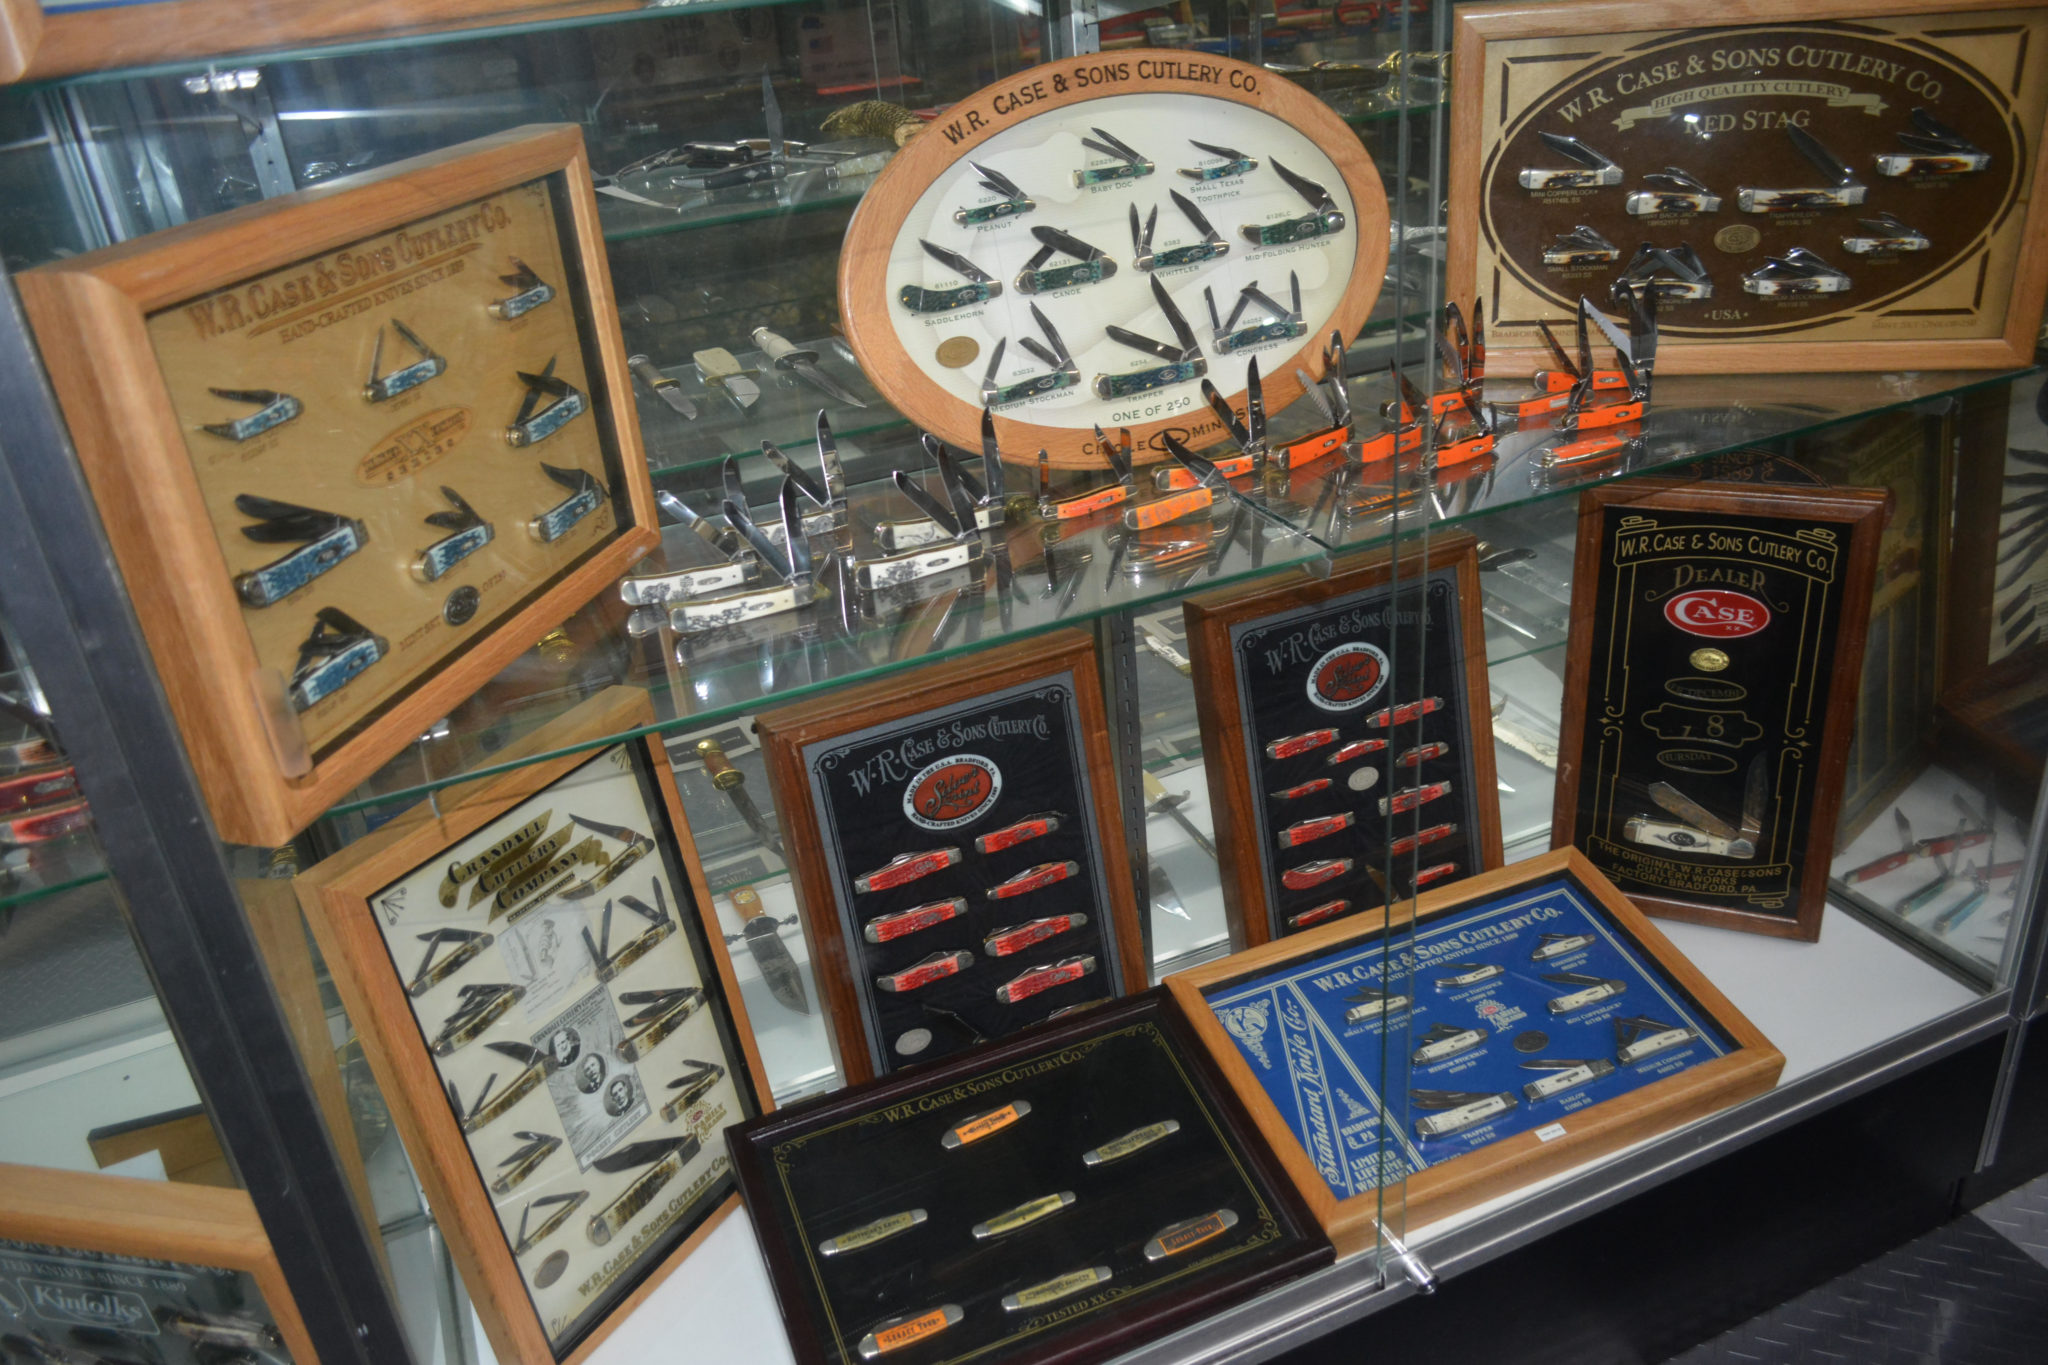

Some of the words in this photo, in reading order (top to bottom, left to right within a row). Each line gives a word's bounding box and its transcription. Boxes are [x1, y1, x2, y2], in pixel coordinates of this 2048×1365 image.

[1557, 86, 1613, 124] W.R.
[1617, 60, 1681, 96] CASE
[1686, 54, 1705, 76] &
[1711, 48, 1780, 72] SONS
[1787, 45, 1904, 84] CUTLERY
[1654, 90, 1695, 110] HIGH
[1699, 82, 1769, 100] QUALITY
[1776, 82, 1846, 98] CUTLERY
[941, 110, 990, 146] W.R.
[992, 81, 1048, 116] CASE
[1052, 73, 1070, 94] &
[1074, 63, 1130, 87] SONS
[1137, 60, 1223, 84] CUTLERY
[1230, 69, 1262, 96] CO.
[1742, 110, 1810, 131] STAG
[1090, 183, 1113, 194] BABY
[1115, 180, 1133, 190] DOC
[1190, 182, 1217, 194] SMALL
[1218, 178, 1244, 188] TEXAS
[1197, 190, 1241, 203] TOOTHPICK
[977, 221, 1012, 233] PEANUT
[1245, 246, 1296, 262] MID-FOLDING
[1298, 240, 1331, 252] HUNTER
[1158, 265, 1200, 279] WHITTLER
[1052, 288, 1082, 298] CANOE
[924, 309, 985, 327] SADDLEHORN
[1711, 309, 1741, 321] USA
[1237, 343, 1278, 357] CONGRESS
[991, 400, 1026, 413] MEDIUM
[1028, 391, 1075, 405] STOCKMAN
[1112, 408, 1141, 422] ONE
[1145, 404, 1162, 417] OF
[1167, 397, 1190, 411] 250
[1126, 391, 1164, 404] TRAPPER
[1621, 536, 1651, 557] W.R.
[1653, 533, 1686, 552] CASE
[1691, 534, 1704, 549] &
[1707, 532, 1743, 552] SONS
[1748, 536, 1801, 563] CUTLERY
[1806, 550, 1830, 574] CO.
[1672, 563, 1768, 592] DEALER
[1675, 597, 1757, 628] CASE
[1707, 715, 1724, 737] 8
[900, 737, 935, 769] CASE
[937, 728, 951, 749] &
[952, 720, 987, 748] SONS
[988, 716, 1031, 741] CUTLERY
[447, 821, 545, 886] CRANDALL
[478, 838, 560, 894] CUTLERY
[1599, 841, 1618, 856] THE
[1622, 851, 1677, 871] ORIGINAL
[1749, 867, 1782, 877] SONS
[496, 851, 580, 909] COMPANY
[1636, 863, 1690, 880] CUTLERY
[1693, 874, 1737, 886] WORKS
[1312, 972, 1358, 992] W.R.
[1414, 938, 1462, 960] SONS
[1459, 914, 1531, 948] CUTLERY
[1530, 907, 1564, 926] CO.
[1289, 1034, 1325, 1096] Knife
[883, 1101, 919, 1124] W.R.
[918, 1095, 953, 1112] CASE
[953, 1087, 968, 1101] &
[967, 1076, 1002, 1095] SONS
[1002, 1059, 1060, 1083] CUTLERY
[1060, 1050, 1085, 1065] CO.
[1340, 1116, 1381, 1136] BRADFORD
[1360, 1131, 1376, 1142] PA
[36, 1263, 89, 1280] KNIVES
[100, 1272, 146, 1288] SINCE
[152, 1278, 187, 1292] 1889
[34, 1285, 143, 1321] Kinfolks
[1045, 1300, 1089, 1322] TESTED
[1090, 1293, 1107, 1305] XX
